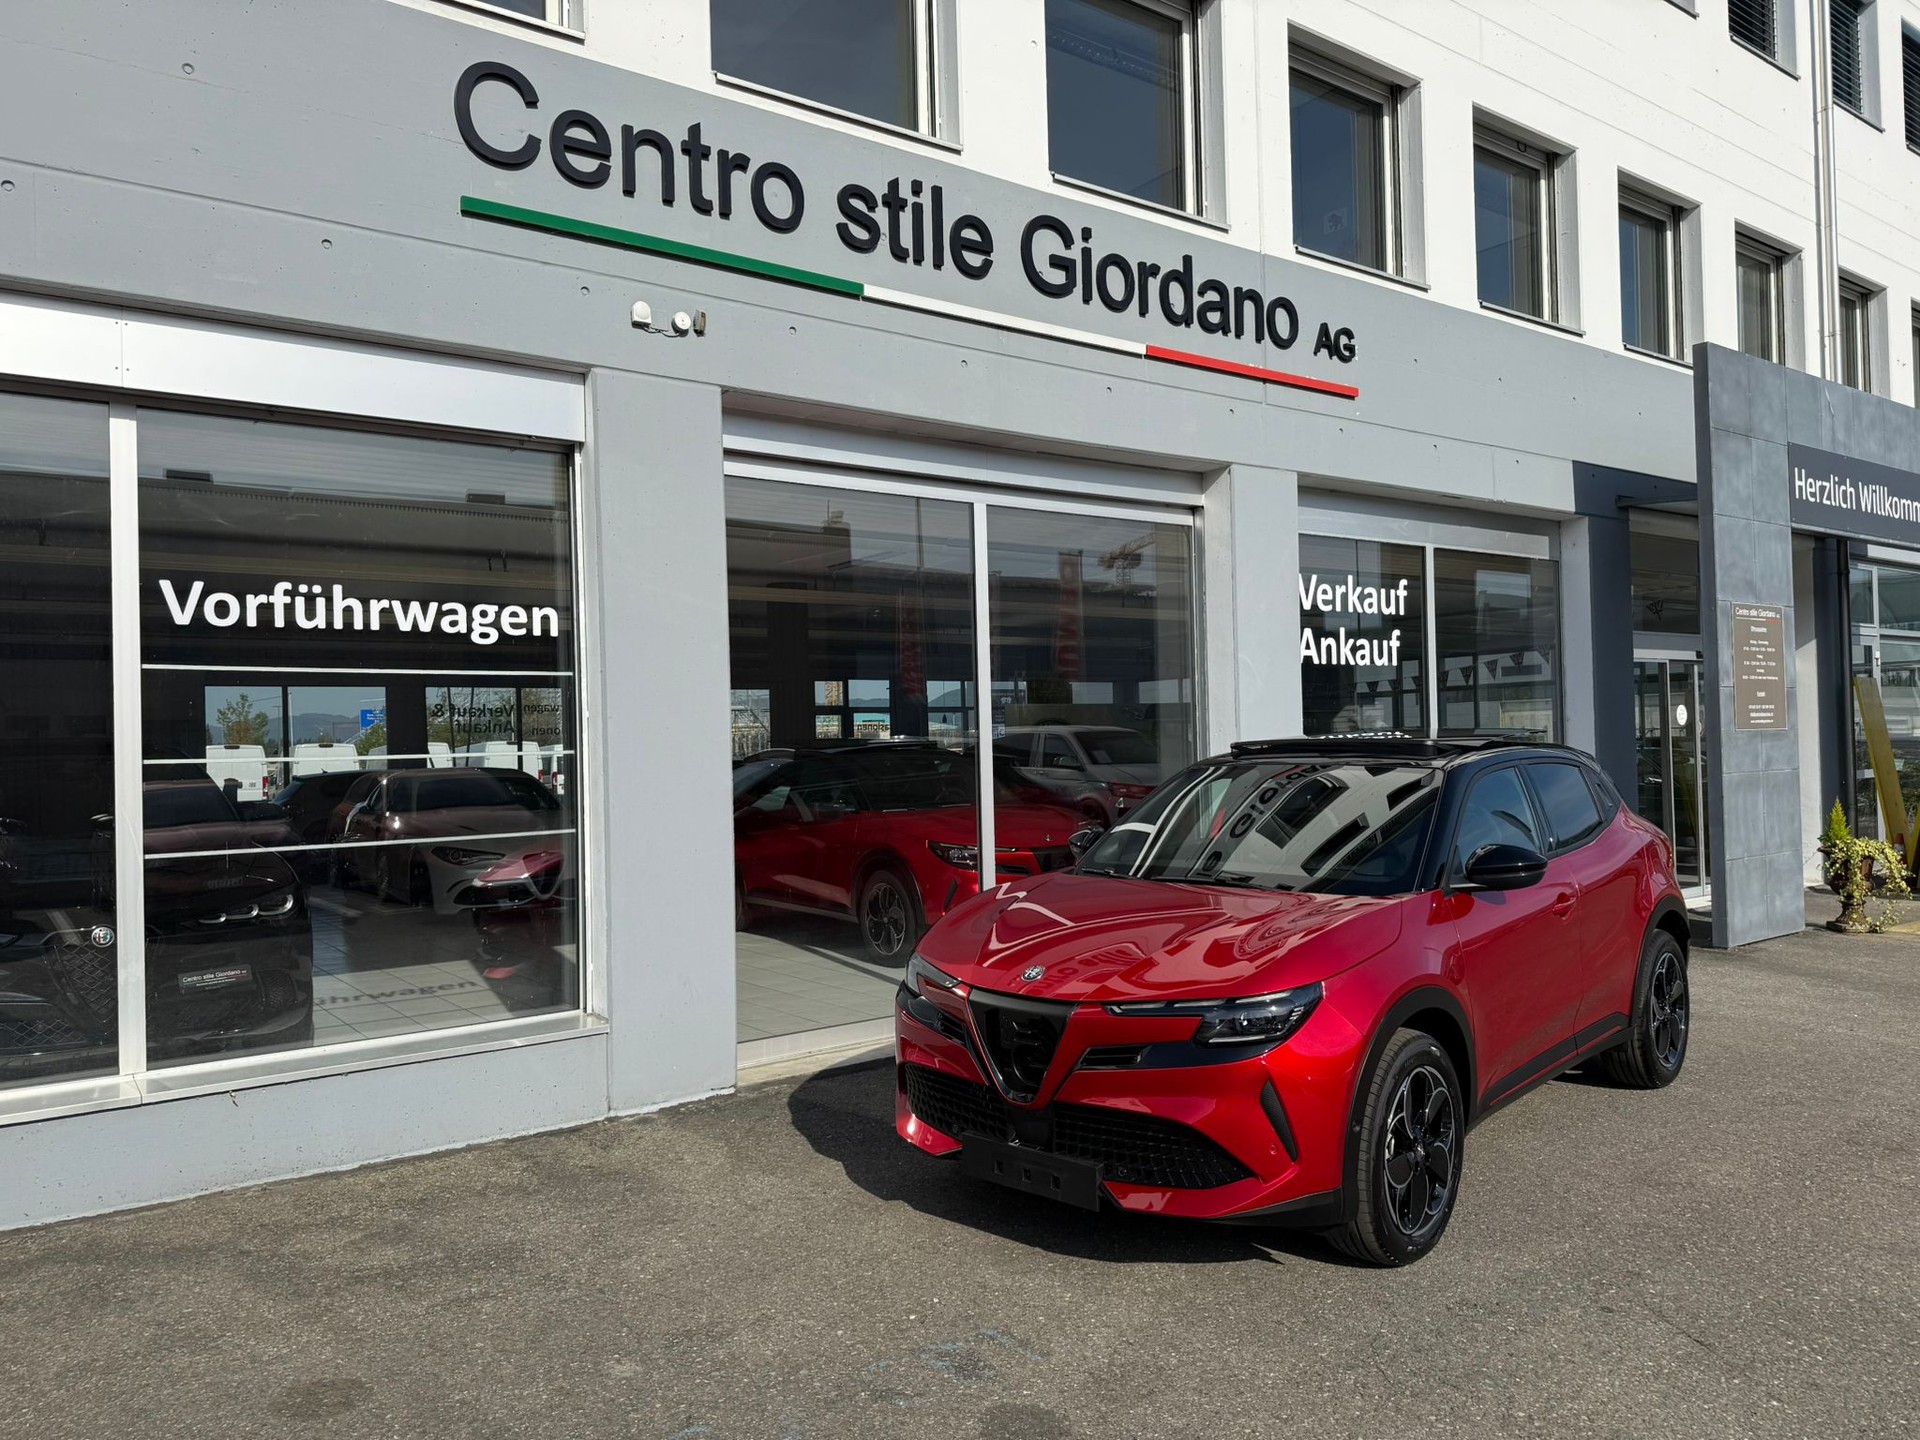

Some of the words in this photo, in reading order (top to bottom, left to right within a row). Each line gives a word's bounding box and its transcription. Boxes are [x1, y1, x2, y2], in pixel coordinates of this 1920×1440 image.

[454, 61, 805, 234] Centro
[836, 177, 994, 281] stile
[1021, 215, 1300, 350] Giordano
[1313, 322, 1357, 363] AG
[1794, 467, 1856, 511] Herzlich
[158, 579, 560, 645] Vorführwagen
[1298, 573, 1408, 616] Verkauf
[1300, 626, 1401, 667] Ankauf
